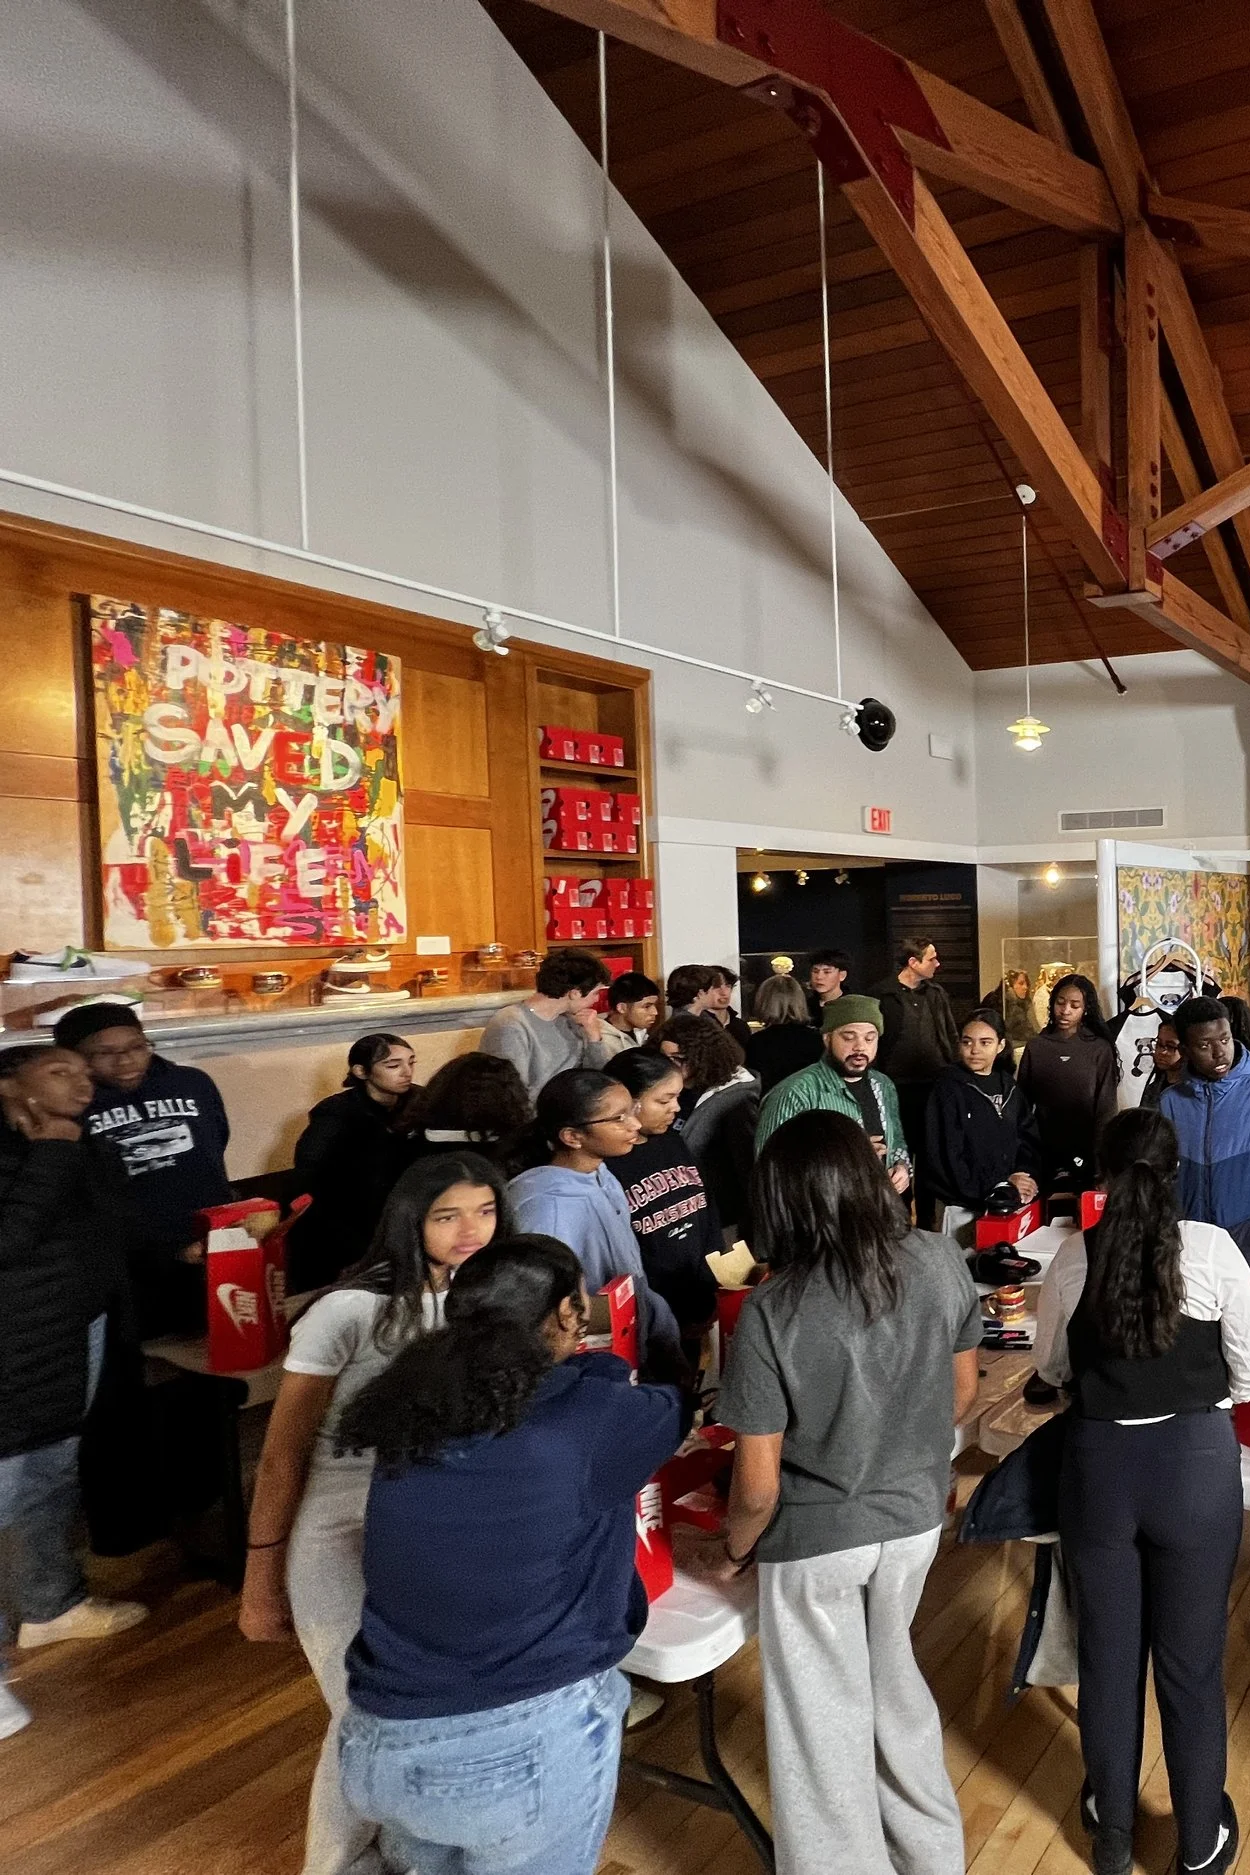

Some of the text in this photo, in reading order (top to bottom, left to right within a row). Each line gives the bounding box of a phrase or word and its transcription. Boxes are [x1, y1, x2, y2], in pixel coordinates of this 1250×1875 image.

[166, 644, 400, 733] POTTERY
[143, 703, 363, 791] SAVED
[211, 781, 318, 842] MY
[871, 807, 890, 831] EXIT
[174, 837, 328, 897] LIFE
[143, 1098, 199, 1119] FALLS
[625, 1165, 704, 1214] ACADEME
[235, 1290, 258, 1325] NIKE
[640, 1482, 664, 1532] NIKE
